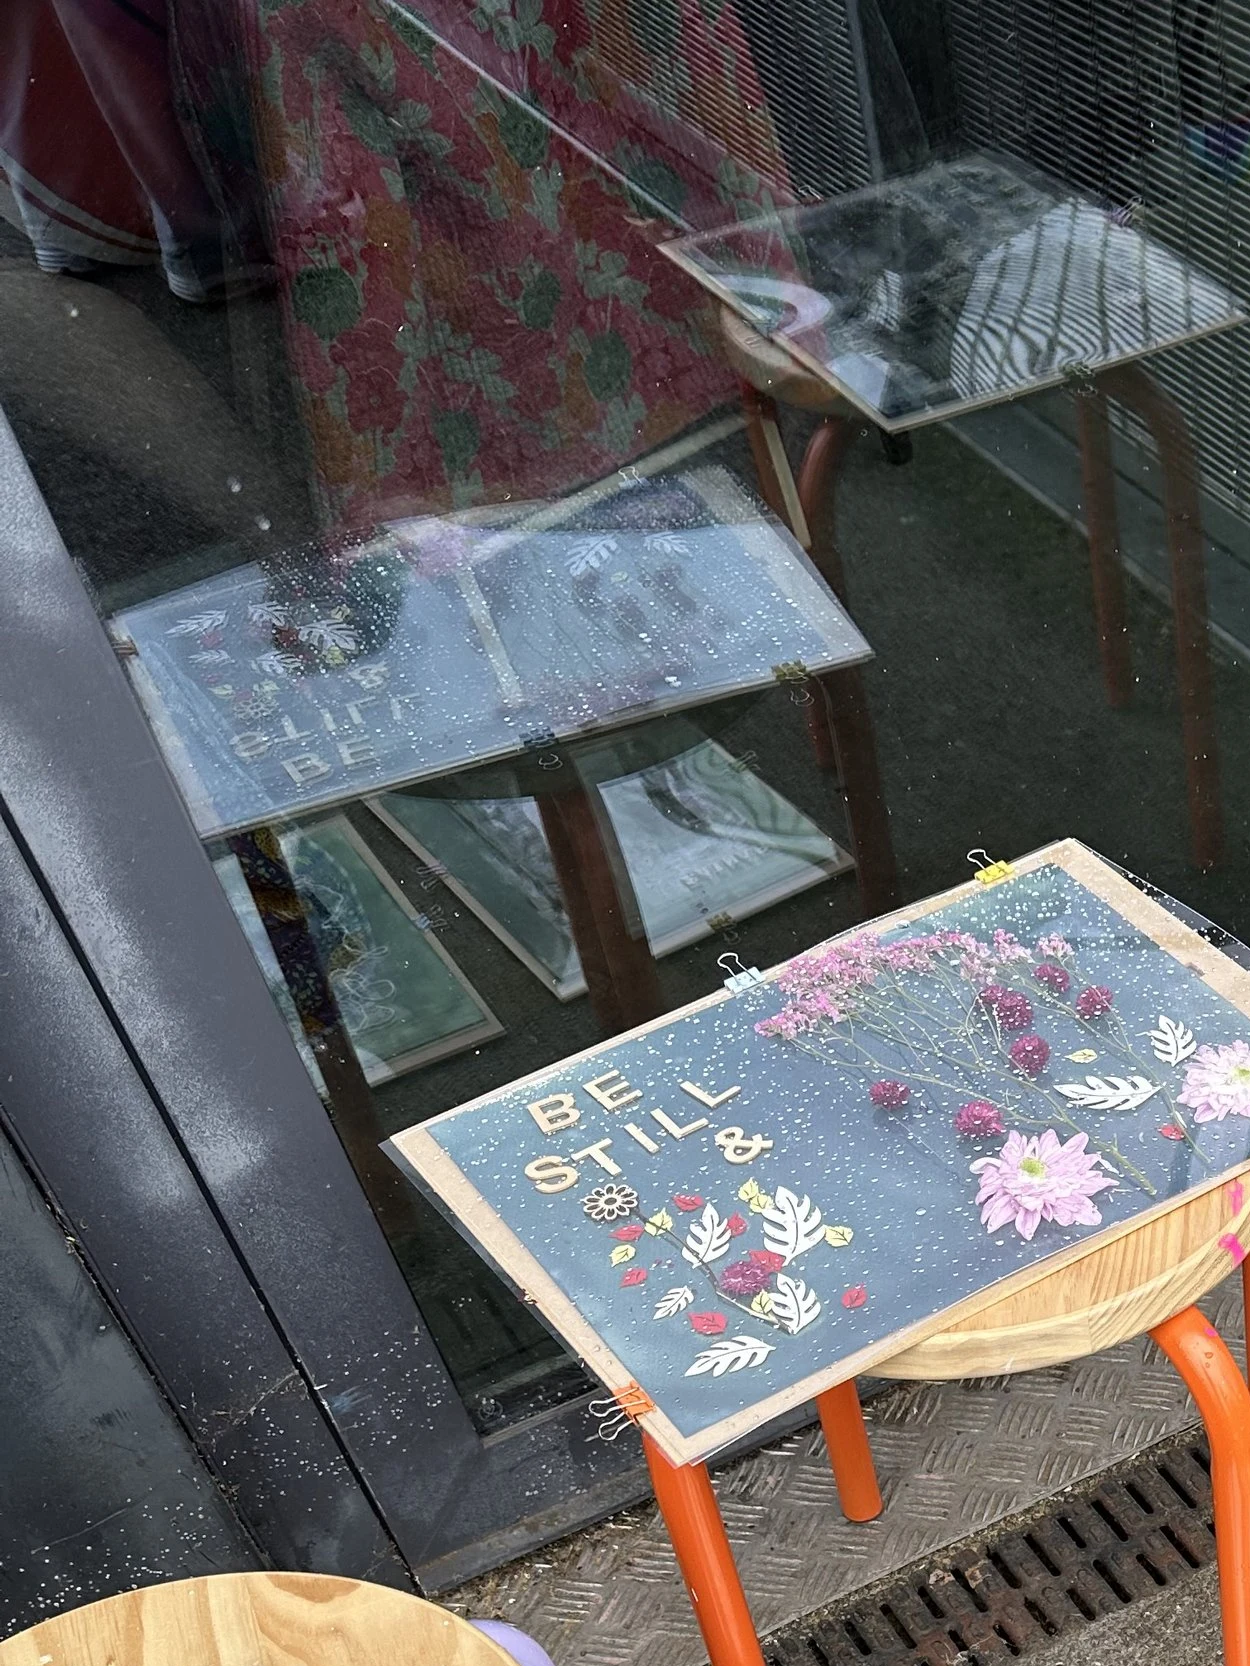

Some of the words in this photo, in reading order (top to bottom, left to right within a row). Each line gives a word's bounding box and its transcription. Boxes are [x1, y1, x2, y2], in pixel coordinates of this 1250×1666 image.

[527, 1069, 643, 1136] BE
[525, 1080, 741, 1194] STILL
[714, 1126, 774, 1165] &
